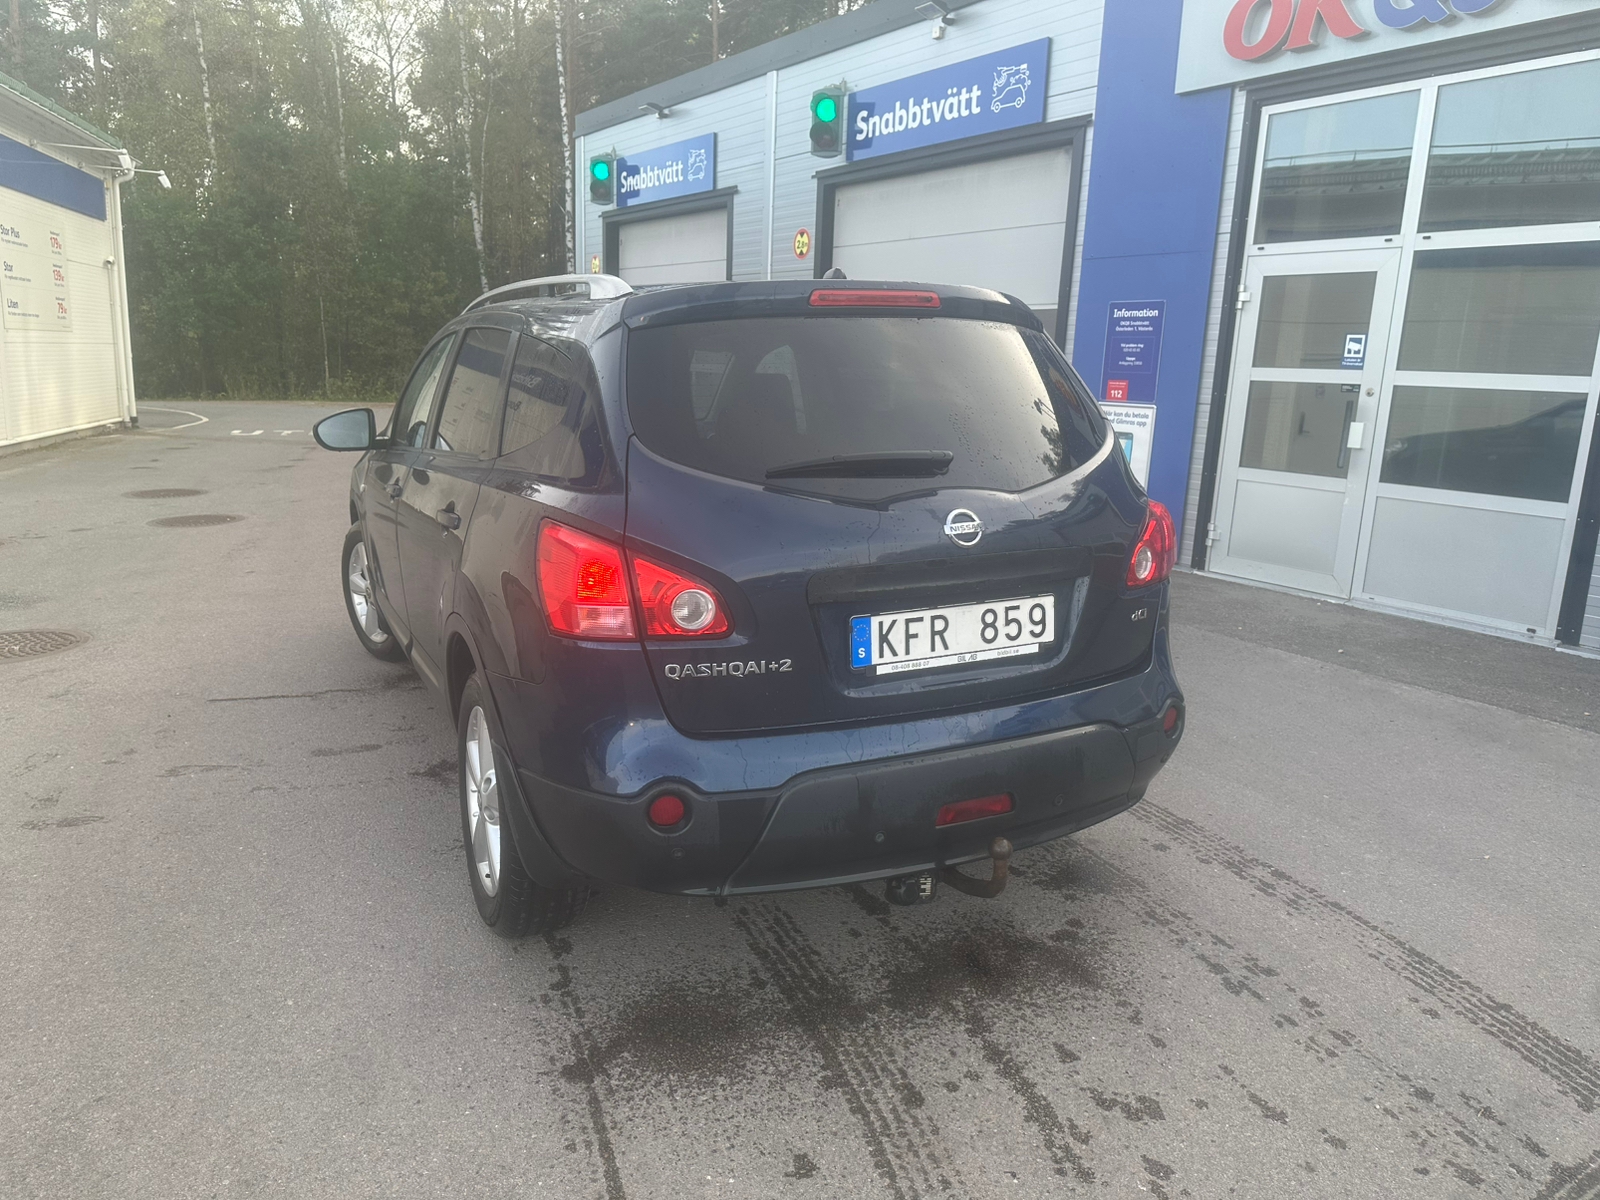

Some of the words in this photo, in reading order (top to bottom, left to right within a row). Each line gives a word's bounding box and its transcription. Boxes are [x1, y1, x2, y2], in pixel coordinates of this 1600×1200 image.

[856, 84, 981, 141] Snabbtvätt
[621, 160, 684, 193] Snabbtvätt
[11, 226, 20, 239] Plus
[3, 261, 14, 272] Stor
[7, 298, 19, 309] Liten
[1113, 308, 1159, 318] Information
[1110, 390, 1123, 398] 112
[878, 614, 950, 659] KFR
[980, 602, 1047, 644] 859
[858, 647, 866, 658] S
[664, 658, 793, 681] QASHQAI+2
